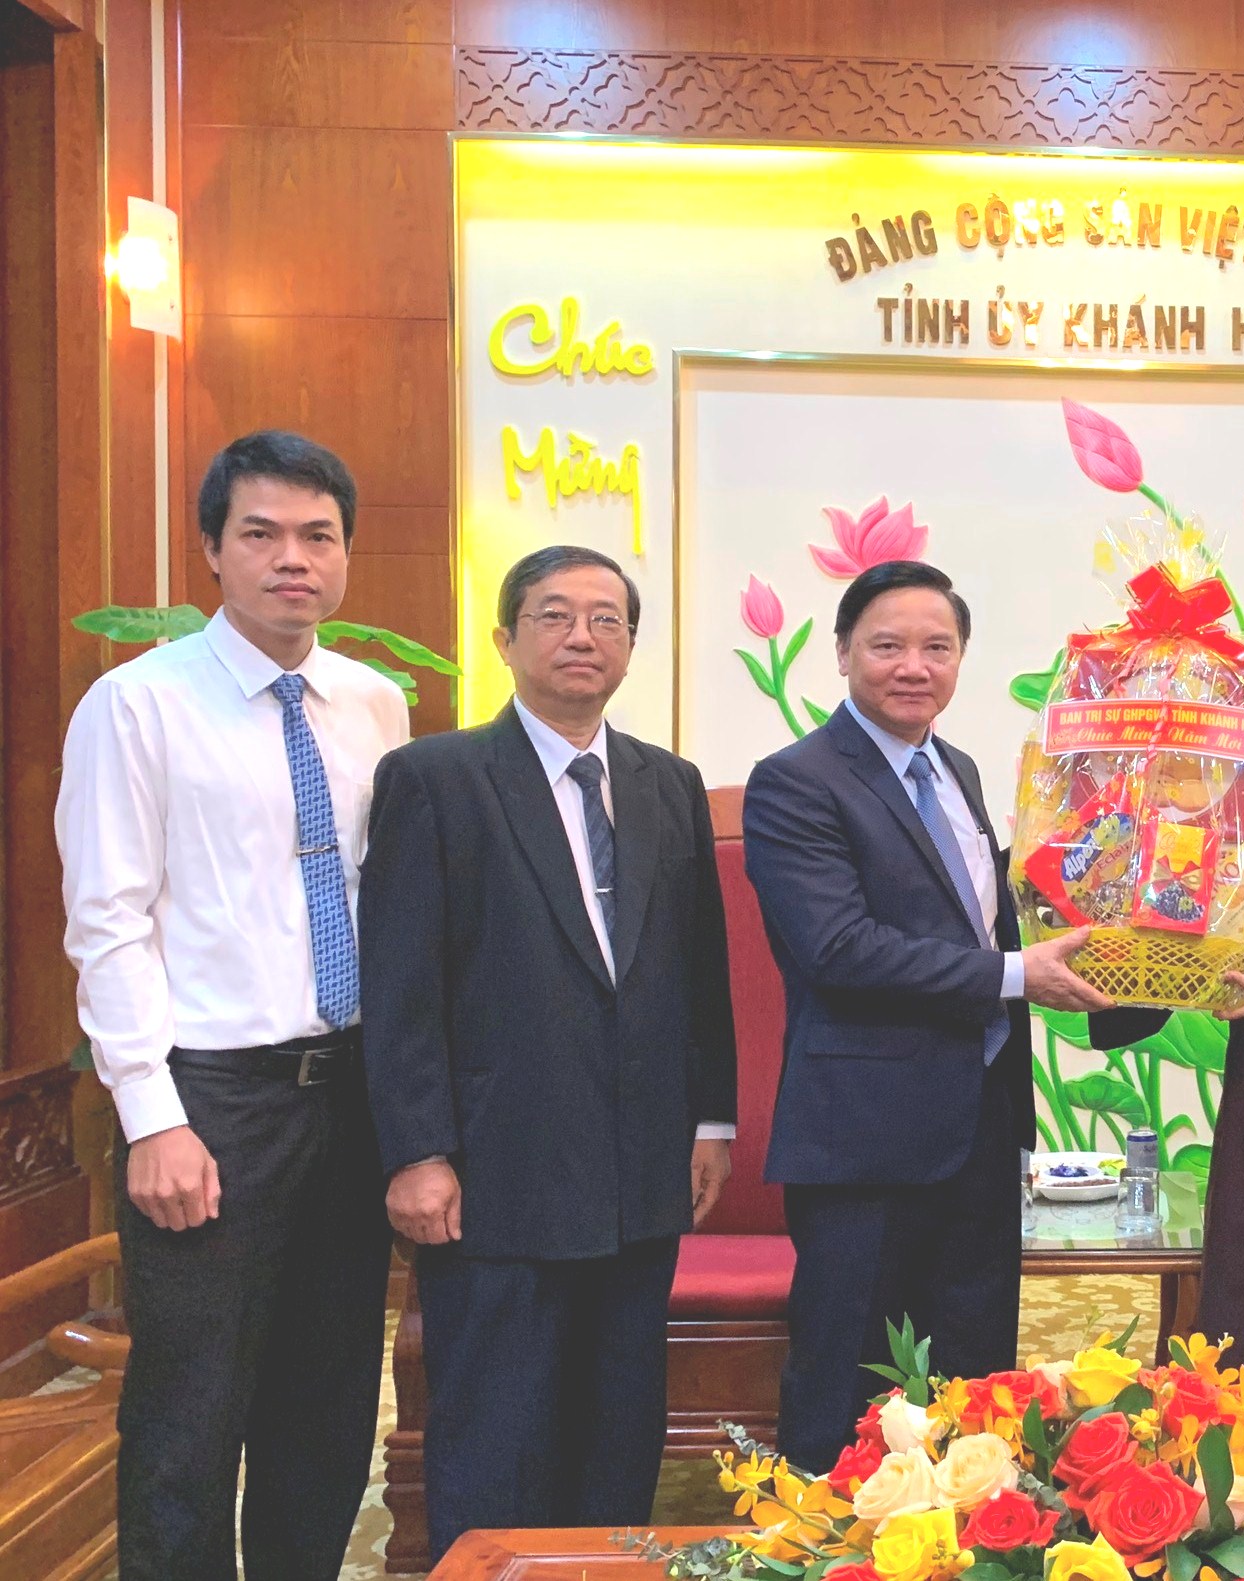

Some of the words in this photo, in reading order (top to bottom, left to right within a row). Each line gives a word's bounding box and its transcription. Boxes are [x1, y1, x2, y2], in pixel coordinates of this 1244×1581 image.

[825, 210, 938, 283] ĐẢNG
[955, 193, 1065, 258] CỘNG
[1084, 187, 1162, 248] SẢN
[488, 296, 655, 377] Chúc
[877, 283, 970, 344] TỈNH
[988, 284, 1044, 347] ỦY
[1063, 293, 1205, 350] KHÁNH
[502, 425, 642, 556] Mừng
[1060, 711, 1083, 725] BAN
[1085, 709, 1103, 724] TRỊ
[1105, 708, 1121, 724] SỰ
[1172, 706, 1198, 724] TỈNH
[1200, 712, 1239, 730] KHÁNH
